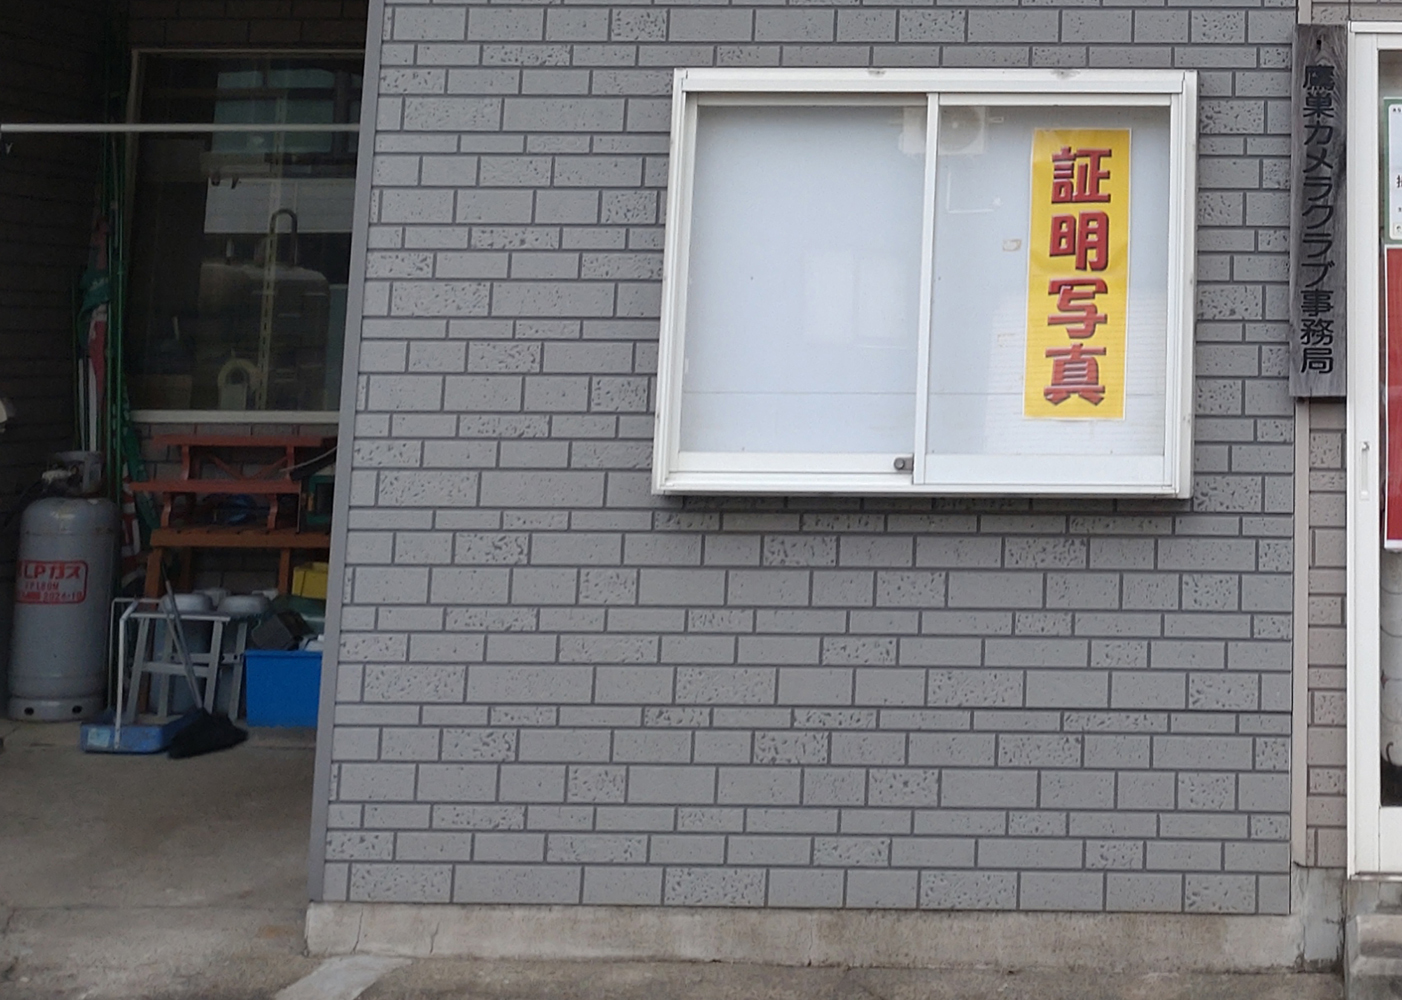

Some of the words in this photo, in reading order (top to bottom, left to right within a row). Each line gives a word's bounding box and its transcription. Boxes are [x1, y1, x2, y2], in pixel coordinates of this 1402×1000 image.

[1043, 146, 1112, 406] 証明写真
[1300, 65, 1335, 375] 鷹巣カメラクラブ事務局
